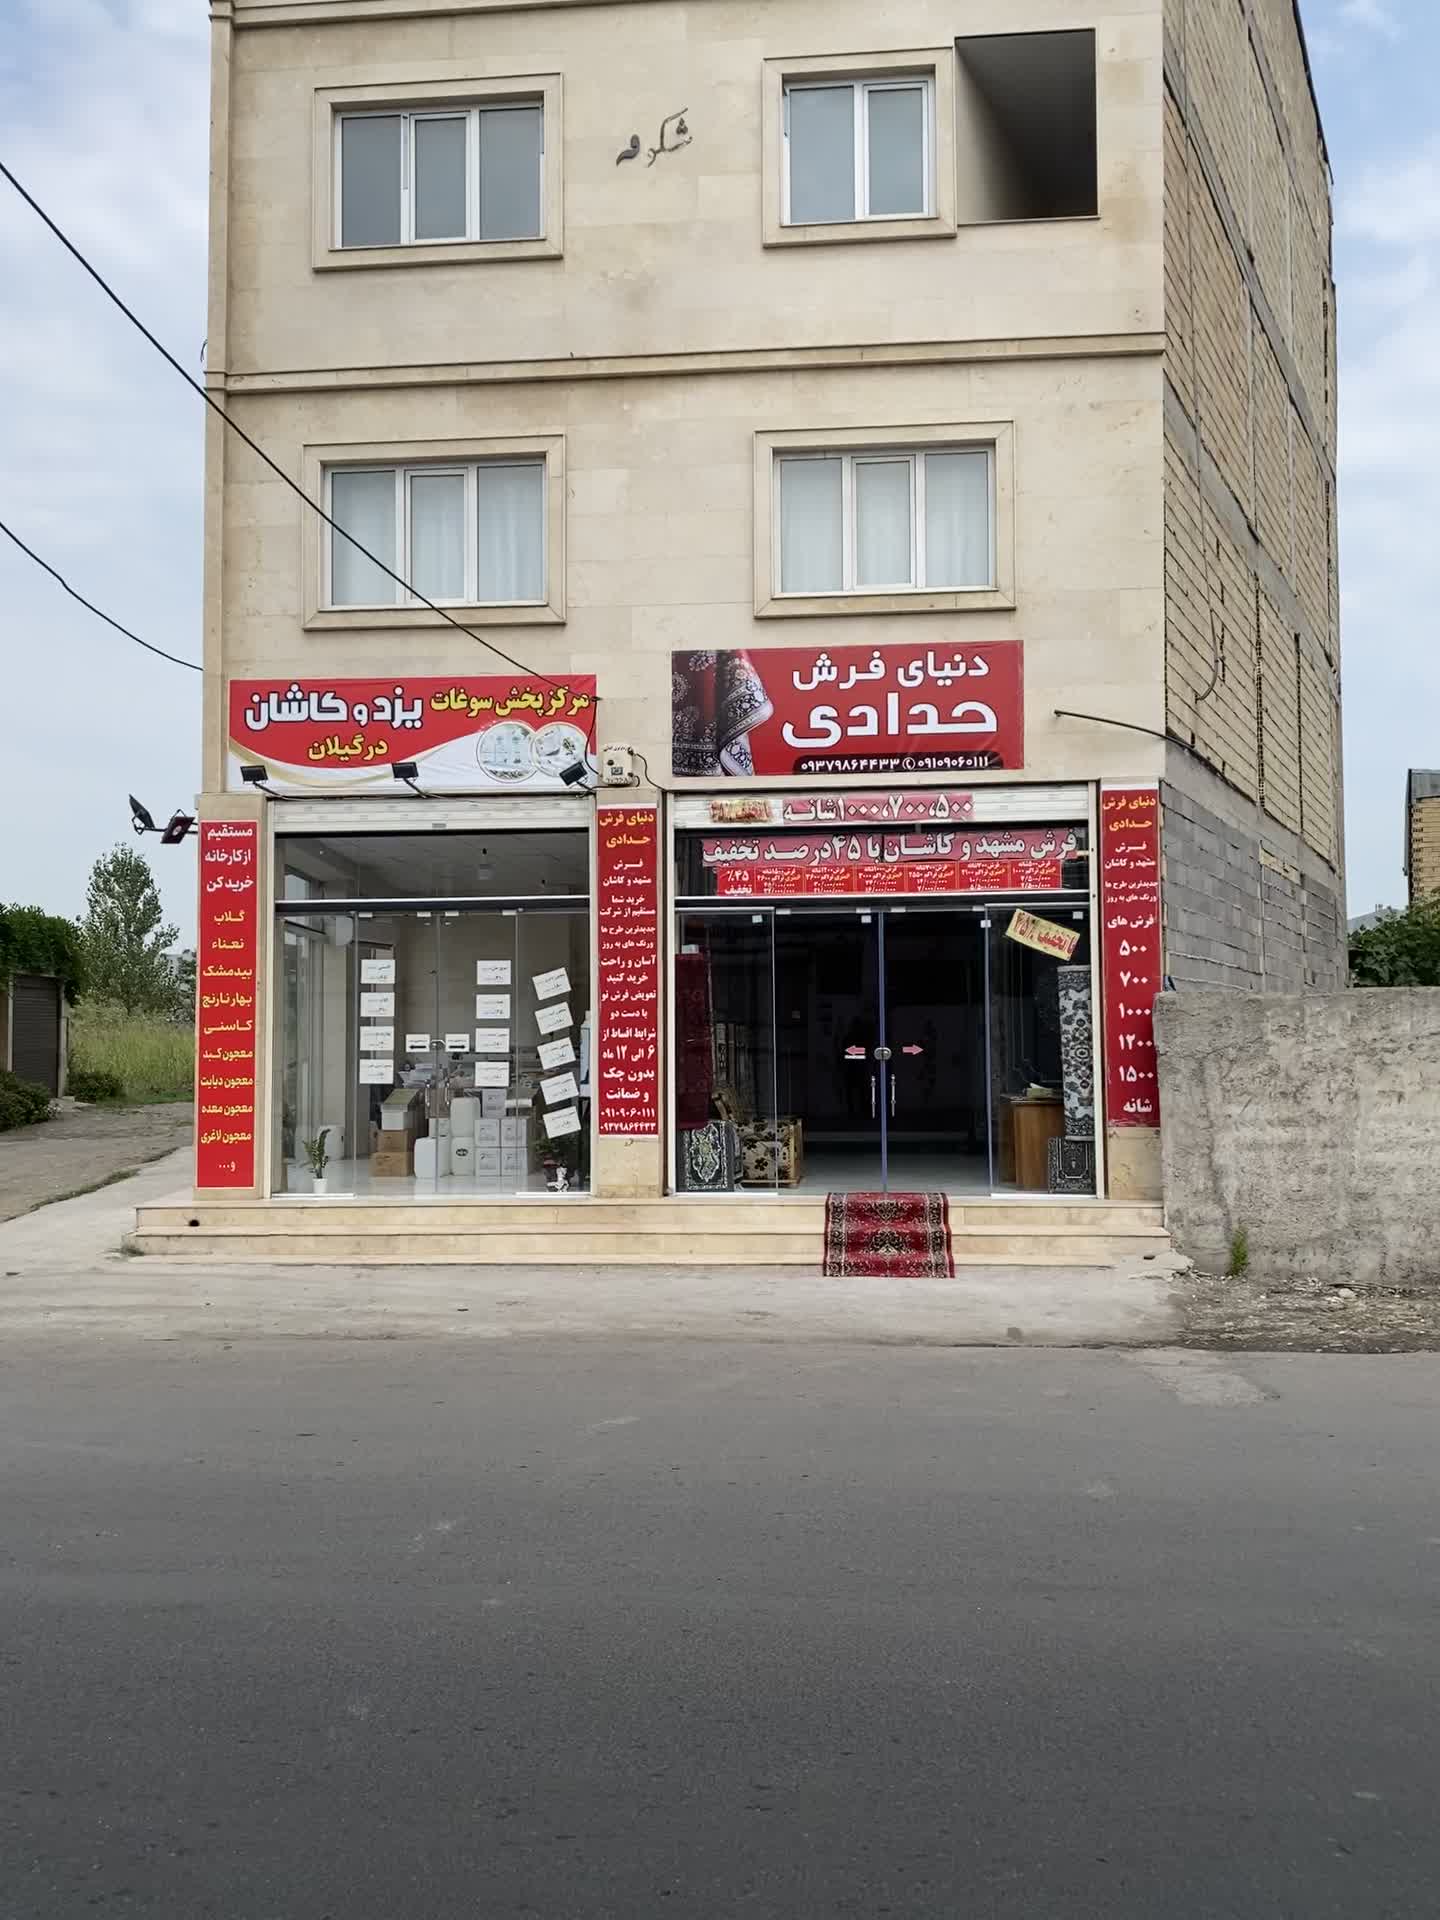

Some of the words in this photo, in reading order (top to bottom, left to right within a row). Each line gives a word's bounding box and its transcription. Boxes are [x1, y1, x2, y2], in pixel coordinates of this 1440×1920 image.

[793, 649, 886, 690] فرش
[898, 651, 990, 687] دنیای
[244, 682, 347, 731] کاشان
[371, 685, 424, 729] یزد
[430, 687, 493, 717] سوغات
[496, 686, 544, 717] پخش
[547, 686, 589, 717] مرکز
[352, 700, 369, 726] و
[782, 692, 998, 748] حدادی
[308, 734, 364, 760] گیلان
[364, 738, 388, 760] در
[1103, 795, 1126, 810] فرش
[1128, 796, 1156, 810] دنیای
[599, 810, 624, 826] فرش
[626, 811, 654, 826] دنیای
[1109, 818, 1152, 831] حدادی
[207, 824, 253, 841] مستقیم
[606, 833, 651, 848] حدادی
[884, 832, 955, 862] کاشان
[976, 832, 1025, 858] مشهد
[1031, 828, 1077, 859] فرش
[1115, 841, 1147, 853] فرش
[703, 839, 760, 866] تخفیف
[867, 835, 880, 863] با
[961, 839, 972, 860] و
[613, 859, 643, 870] فرش
[1104, 858, 1127, 869] کاشان
[1130, 859, 1134, 869] و
[1135, 857, 1156, 866] مشهد
[603, 875, 624, 886] کاشان
[627, 878, 631, 886] و
[633, 875, 652, 885] مشهد
[611, 894, 624, 904] شما
[626, 894, 645, 905] خرید
[214, 910, 245, 925] گلاب
[599, 906, 621, 917] شرکت
[624, 906, 631, 917] از
[632, 906, 656, 917] مستقیم
[1107, 914, 1128, 928] های
[1130, 914, 1155, 928] فرش
[1119, 939, 1147, 956] ۵۰۰
[600, 955, 625, 969] راحت
[627, 959, 632, 969] و
[634, 954, 656, 968] آسان
[606, 972, 624, 984] کنید
[627, 972, 648, 984] خرید
[1119, 970, 1148, 987] ۷۰۰
[601, 991, 609, 1001] نو
[610, 990, 629, 1001] فرش
[630, 990, 656, 1001] تعویض
[1118, 1002, 1151, 1019] ۱۰۰۰
[203, 1020, 253, 1035] کاسنی
[602, 1027, 609, 1041] از
[611, 1027, 632, 1038] اقساط
[634, 1028, 656, 1041] شرایط
[1118, 1034, 1153, 1050] ۱۲۰۰
[222, 1050, 253, 1062] معجون
[602, 1048, 614, 1059] ماه
[616, 1045, 627, 1060] ۱۲
[631, 1048, 644, 1062] الی
[647, 1044, 655, 1059] ۶
[603, 1067, 625, 1082] چک
[628, 1068, 655, 1081] بدون
[1119, 1065, 1154, 1082] ۱۵۰۰
[224, 1075, 253, 1089] معجون
[606, 1088, 641, 1100] ضمانت
[643, 1092, 649, 1102] و
[201, 1104, 223, 1114] معده
[224, 1104, 252, 1117] معجون
[1123, 1098, 1152, 1113] شانه
[222, 1131, 251, 1144] معجون
